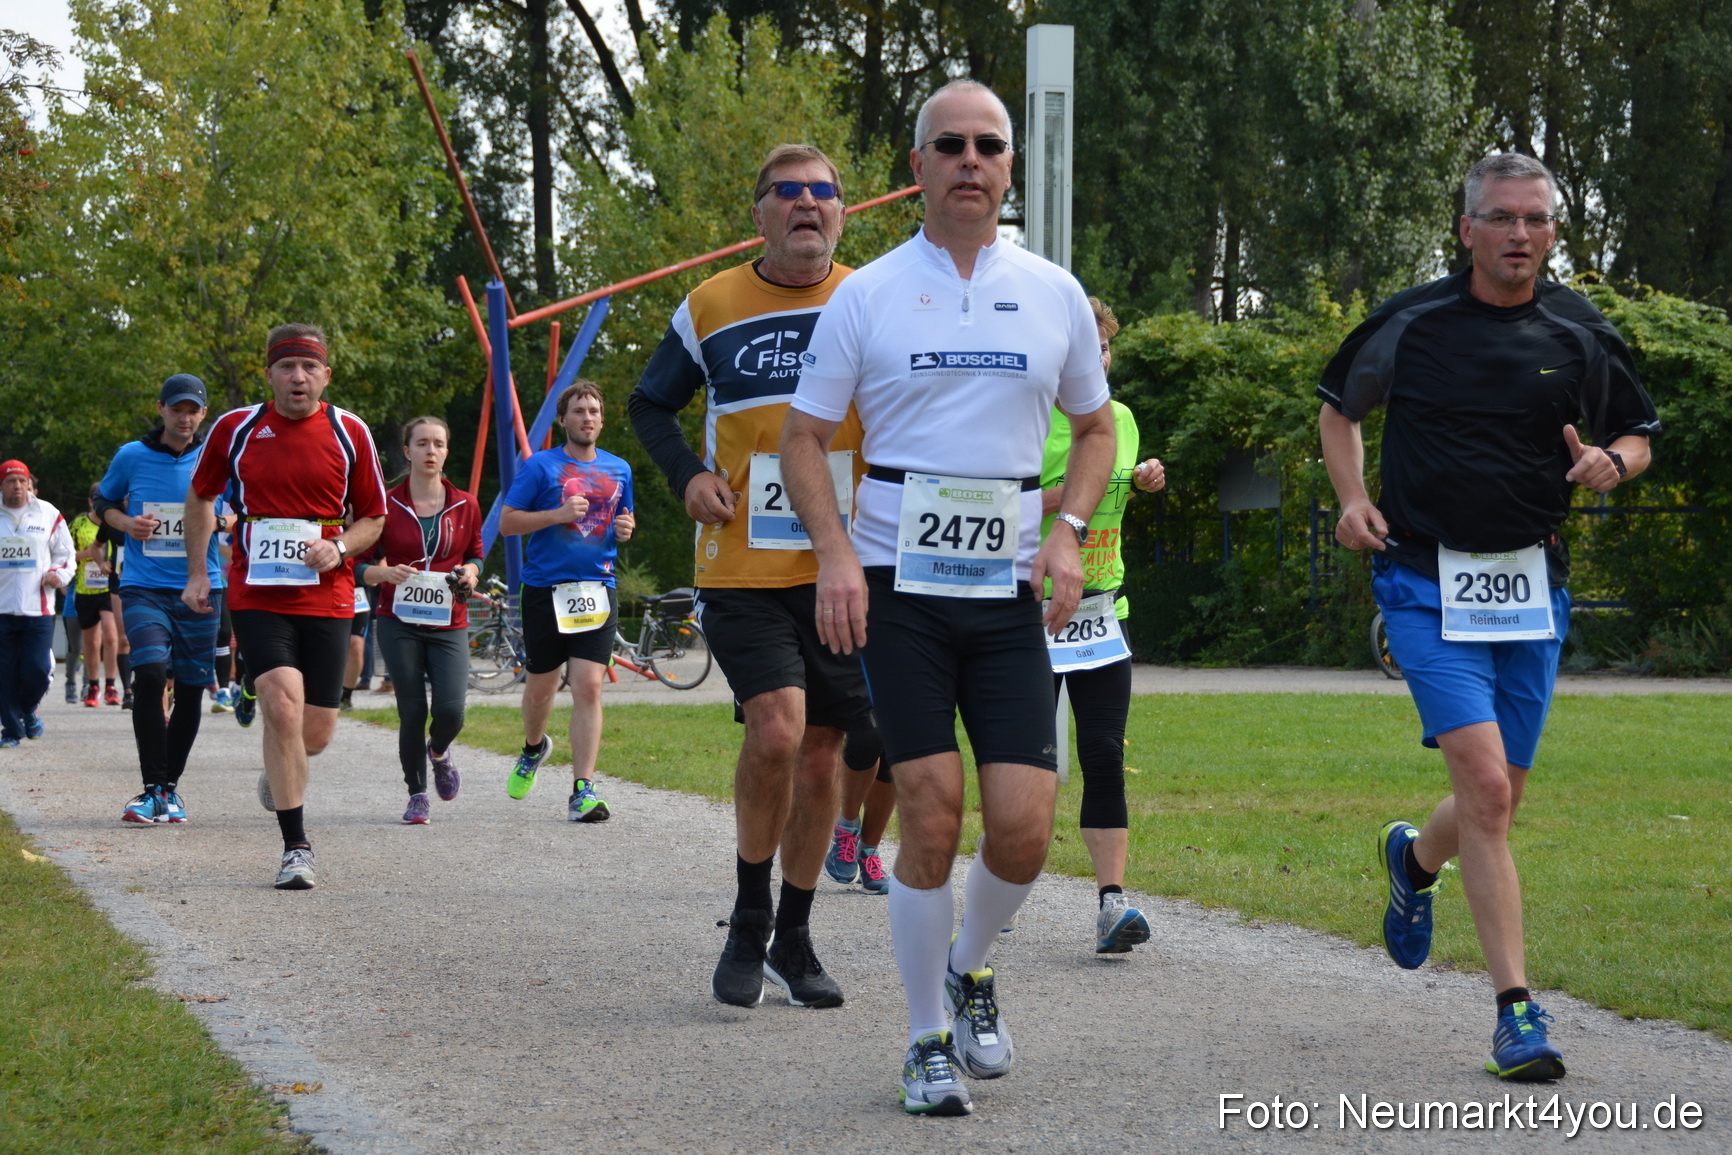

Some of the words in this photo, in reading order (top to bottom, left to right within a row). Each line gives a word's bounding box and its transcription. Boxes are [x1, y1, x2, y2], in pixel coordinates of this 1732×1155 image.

[945, 354, 1024, 368] BÜSCHEL
[910, 370, 977, 379] FEINSCHNEIDTECHNIK
[981, 371, 1028, 380] WERKZEUGBAU
[951, 488, 993, 501] BOCK
[917, 512, 1006, 552] 2479
[1, 546, 31, 558] 2244
[258, 539, 310, 561] 2158
[1481, 551, 1518, 561] BOCK
[274, 565, 290, 574] Max
[932, 561, 986, 577] Matthias
[1454, 571, 1531, 604] 2390
[402, 586, 445, 605] 2006
[566, 597, 597, 614] 239
[412, 608, 433, 616] Bianca
[573, 616, 595, 624] Manuel
[1469, 614, 1520, 626] Reinhard
[1075, 647, 1096, 659] Gabi
